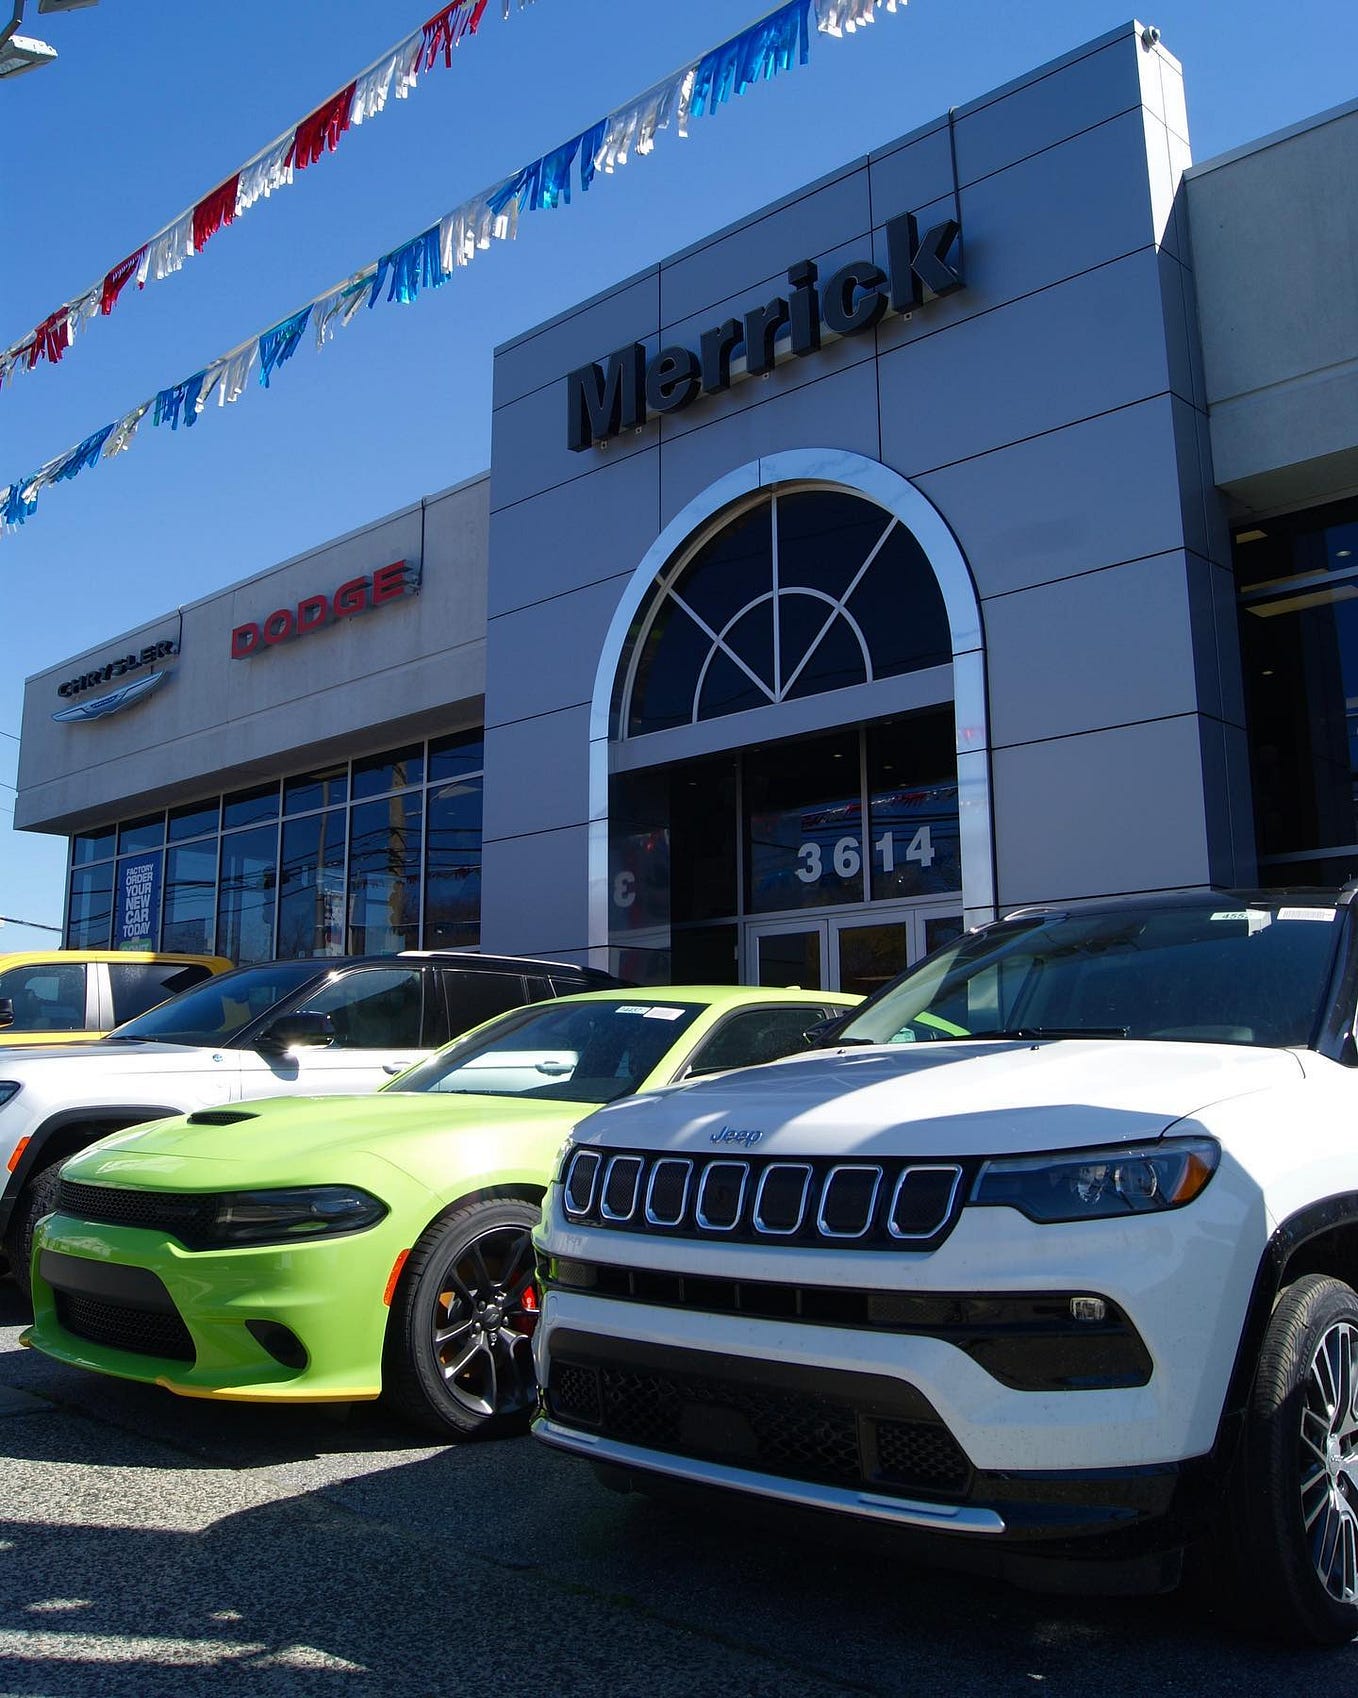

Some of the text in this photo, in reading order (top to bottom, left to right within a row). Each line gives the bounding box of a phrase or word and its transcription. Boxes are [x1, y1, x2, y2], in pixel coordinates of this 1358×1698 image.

[567, 211, 966, 453] Merrick
[231, 559, 408, 660] DODGE
[57, 640, 174, 698] CHRYSLER
[796, 825, 936, 883] 3614
[126, 864, 154, 876] FACTORY
[126, 872, 153, 885] ORDER
[126, 882, 152, 897] YOUR
[126, 894, 151, 911] NEW
[126, 908, 149, 925] CAR
[123, 921, 150, 937] TODAY
[710, 1125, 763, 1149] Jeep
